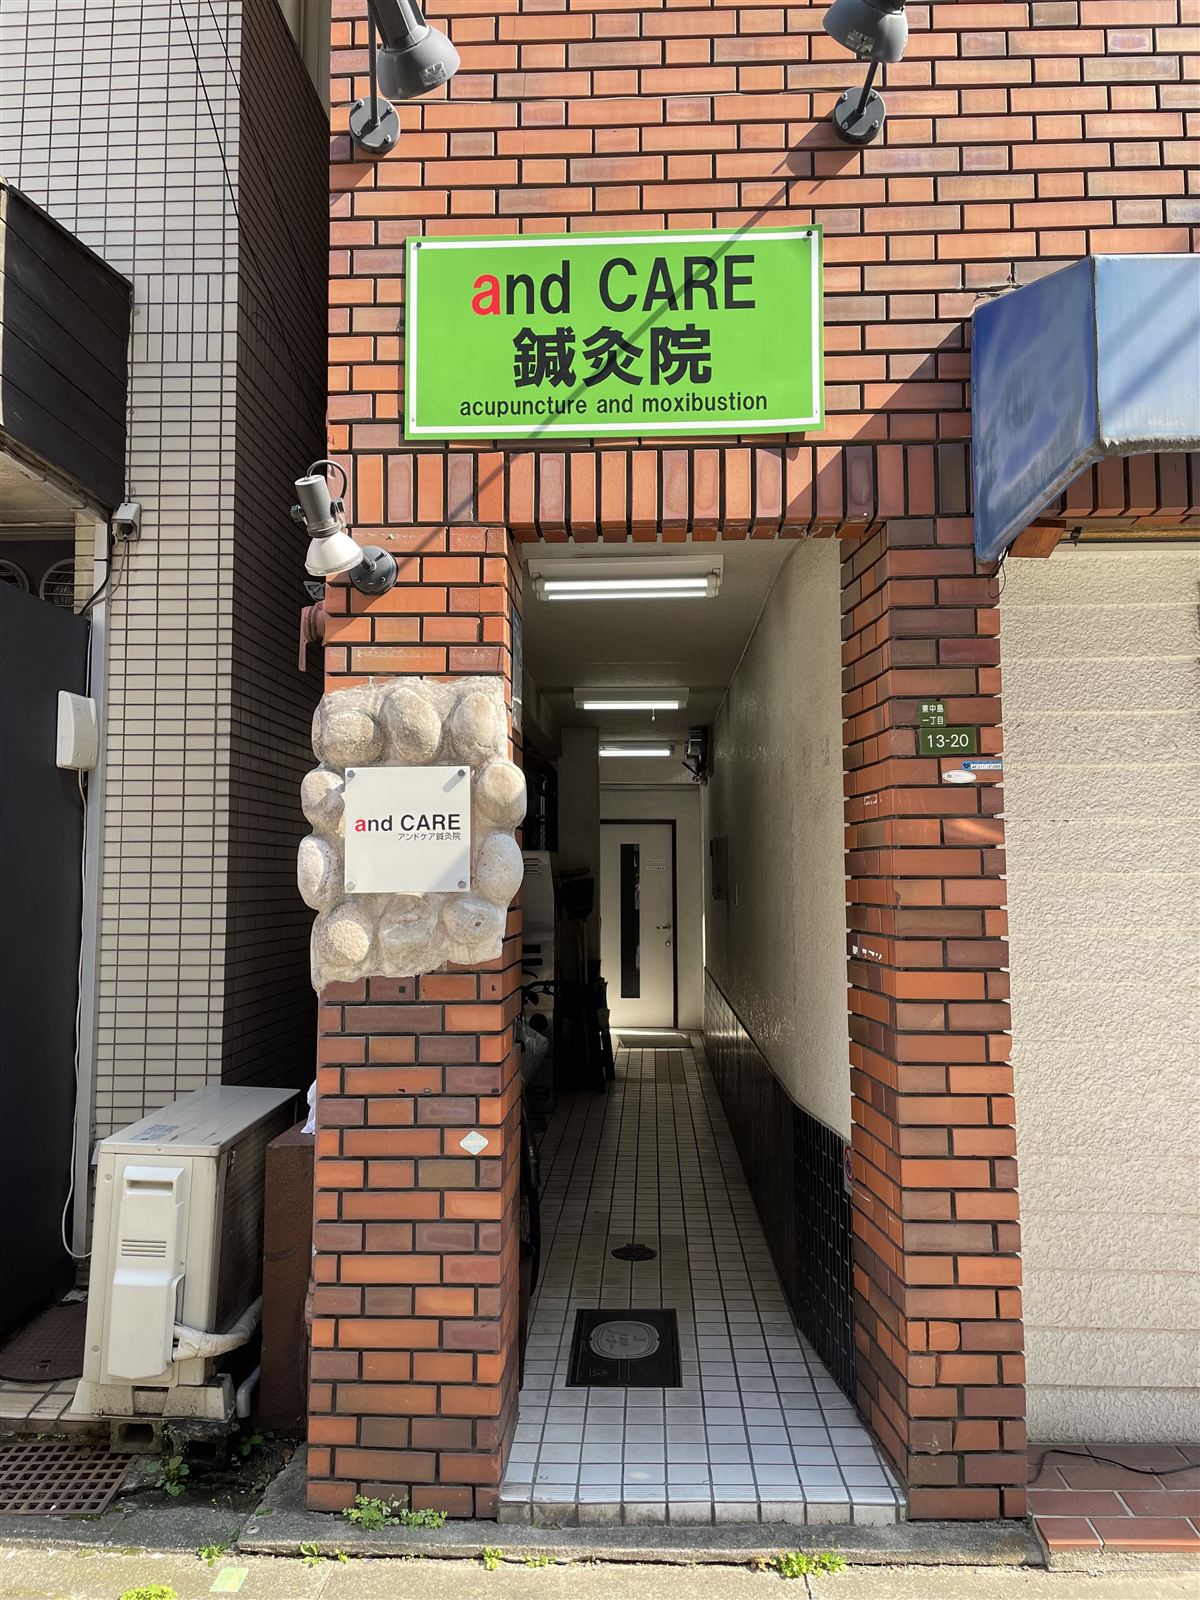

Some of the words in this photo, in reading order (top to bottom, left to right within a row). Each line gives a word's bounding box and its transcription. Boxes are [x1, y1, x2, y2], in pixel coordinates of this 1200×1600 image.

[471, 259, 570, 316] and
[599, 254, 756, 312] CARE
[512, 323, 712, 388] 鍼灸院
[459, 397, 587, 418] acupuncture
[596, 394, 633, 414] and
[642, 391, 768, 413] moxibustion
[921, 703, 944, 713] 東中島
[921, 715, 944, 725] 一丁目
[927, 733, 969, 748] 13-20
[354, 814, 393, 832] and
[400, 813, 461, 832] CARE
[398, 832, 461, 841] アンドケア鍼灸院
